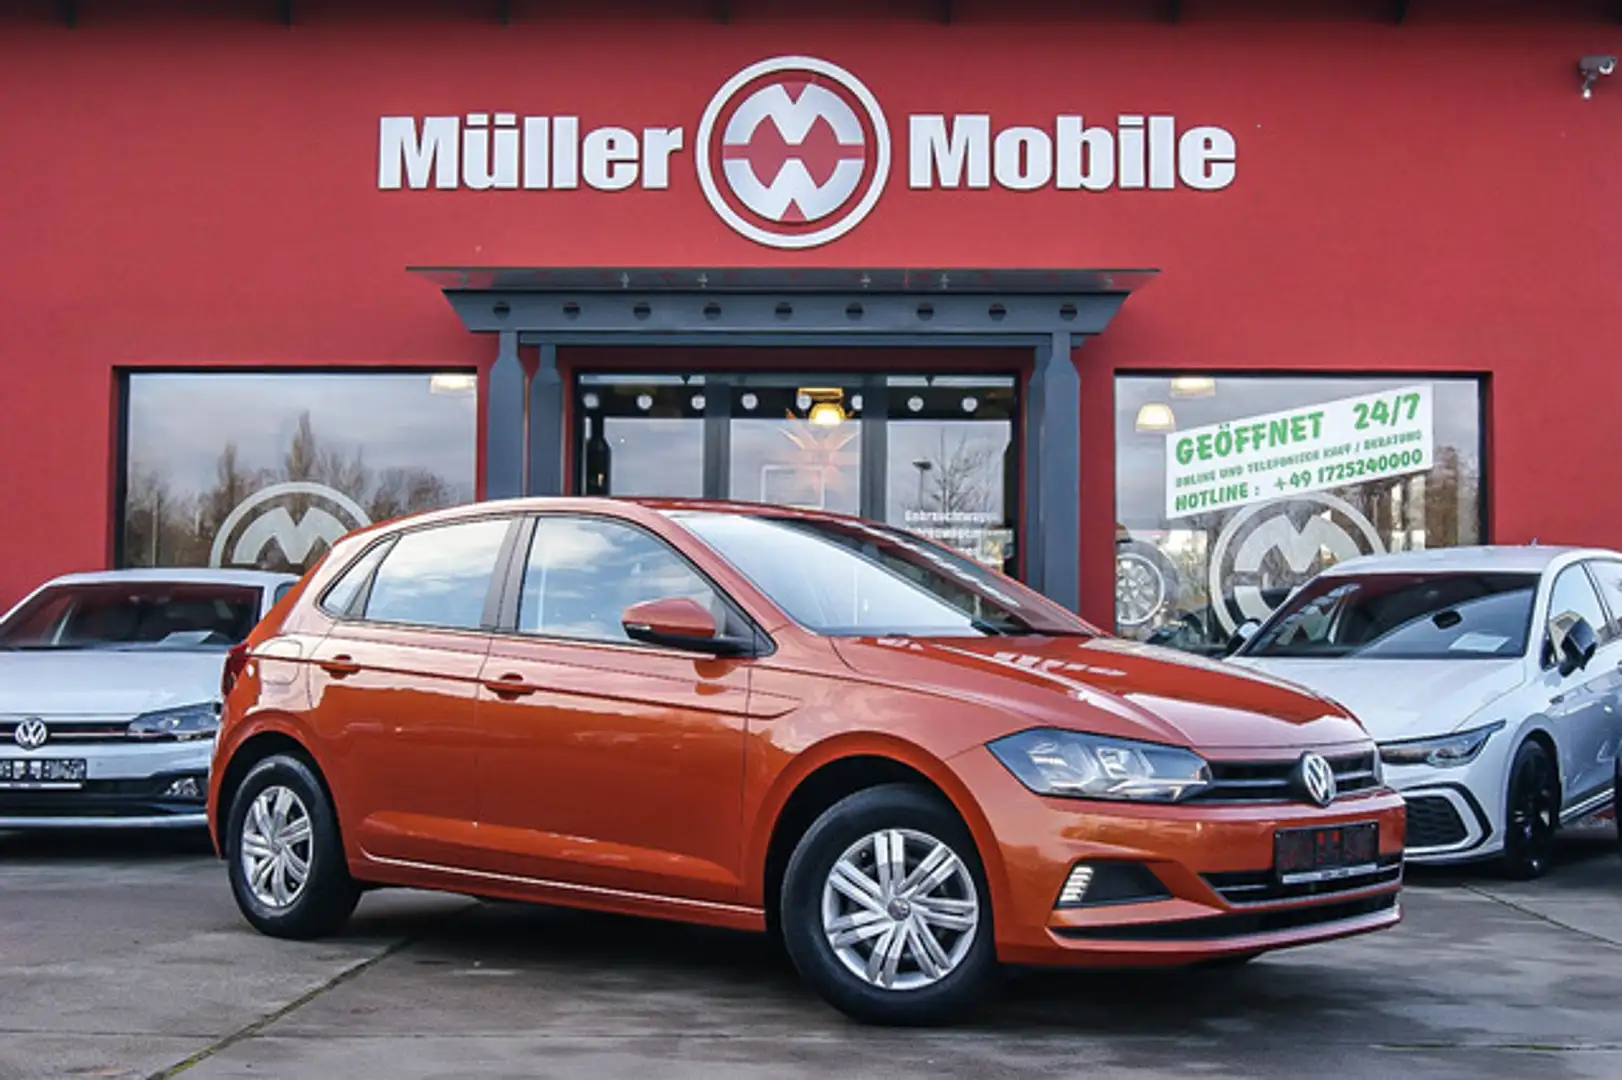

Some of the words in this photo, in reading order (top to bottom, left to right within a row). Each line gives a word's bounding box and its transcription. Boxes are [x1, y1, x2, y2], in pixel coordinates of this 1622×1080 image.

[378, 113, 683, 190] Müller
[908, 113, 1237, 191] Mobile
[1175, 411, 1324, 465] GEÖFFNET
[1353, 392, 1421, 430] 24/7
[1175, 470, 1216, 488] ONLINE
[1219, 464, 1243, 480] UND
[1175, 482, 1249, 511] HOTLINE
[1274, 471, 1312, 491] +49
[1317, 448, 1424, 484] 1725240000
